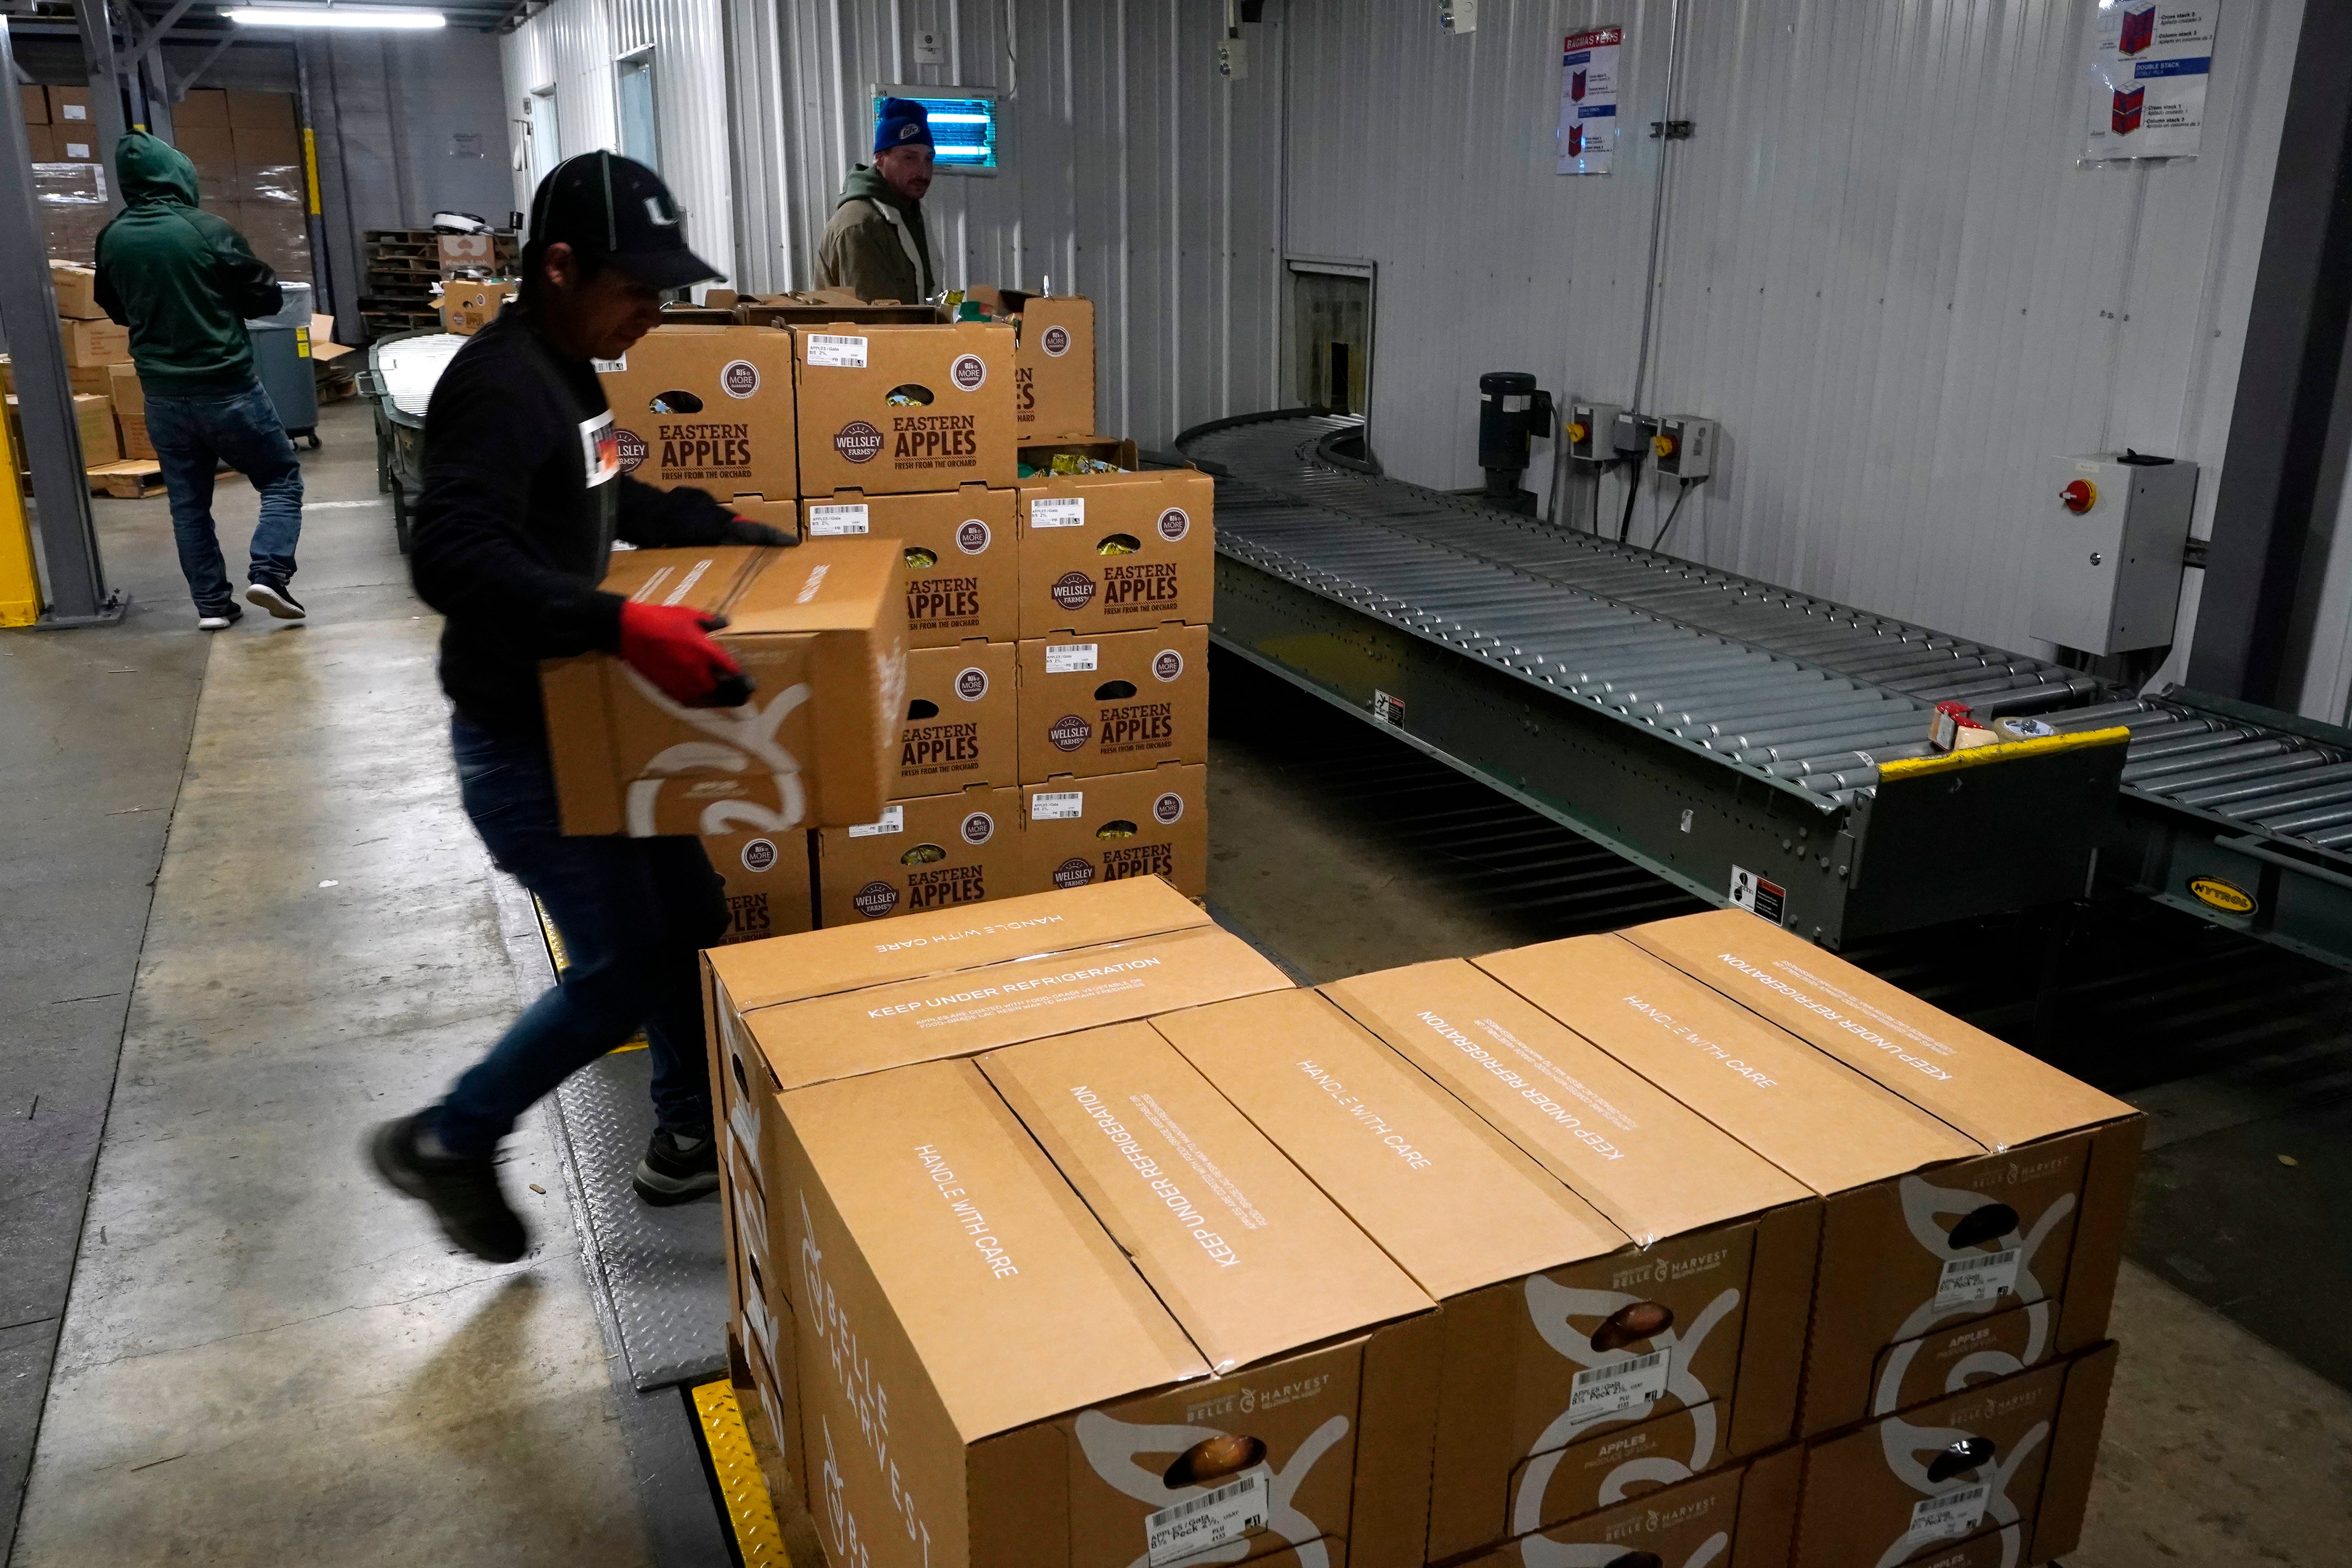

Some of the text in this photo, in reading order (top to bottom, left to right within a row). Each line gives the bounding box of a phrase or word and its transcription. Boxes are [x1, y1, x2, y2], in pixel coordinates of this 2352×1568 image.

[659, 424, 748, 440] EASTERN
[894, 415, 975, 432] EASTERN
[616, 444, 645, 457] LSLEY
[836, 436, 881, 448] WELLSLEY
[894, 430, 977, 458] APPLES
[661, 439, 751, 467] APPLES
[1104, 563, 1177, 580] EASTERN
[908, 577, 978, 594] ASTERN
[1054, 585, 1093, 596] WELLSLEY
[1105, 576, 1178, 604] APPLES
[1158, 663, 1177, 671] MORE
[1100, 703, 1171, 721] EASTERN
[902, 723, 977, 742] EASTERN
[1050, 727, 1089, 740] WELLSLEY
[1101, 716, 1172, 744] APPLES
[901, 736, 979, 766] APPLES
[1146, 741, 1172, 749] ORCHARD
[951, 763, 979, 772] ORCHARD
[967, 825, 987, 833] MORE
[749, 851, 771, 860] MORE
[1103, 843, 1172, 864] EASTERN
[908, 864, 983, 886] EASTERN
[1055, 868, 1092, 881] WELLSLEY
[1104, 855, 1173, 882] APPLES
[856, 892, 897, 907] WELLSLEY
[909, 878, 985, 909] APPLES
[2195, 883, 2248, 908] HYTROL
[734, 906, 770, 932] LES
[874, 914, 1064, 953] HANDLE WITH CARE
[868, 957, 1162, 1019] KEEP UNDER REFRIGERATION
[1717, 953, 1954, 1082] KEEP UNDER REFRIGERATION
[1622, 995, 1778, 1090] HANDLE WITH CARE
[1417, 1010, 1625, 1161] KEEP UNDER REFRIGERATION
[1296, 1060, 1432, 1170] HANDLE WITH CARE
[1070, 1085, 1241, 1268] KEEP UNDER REFRIGERATION
[914, 1143, 1019, 1280] HANDLE WITH CARE
[1261, 1374, 1329, 1402] HARVEST
[1599, 1432, 1646, 1456] APPLES
[1173, 1526, 1198, 1540] Peck
[1212, 1526, 1224, 1534] PLU
